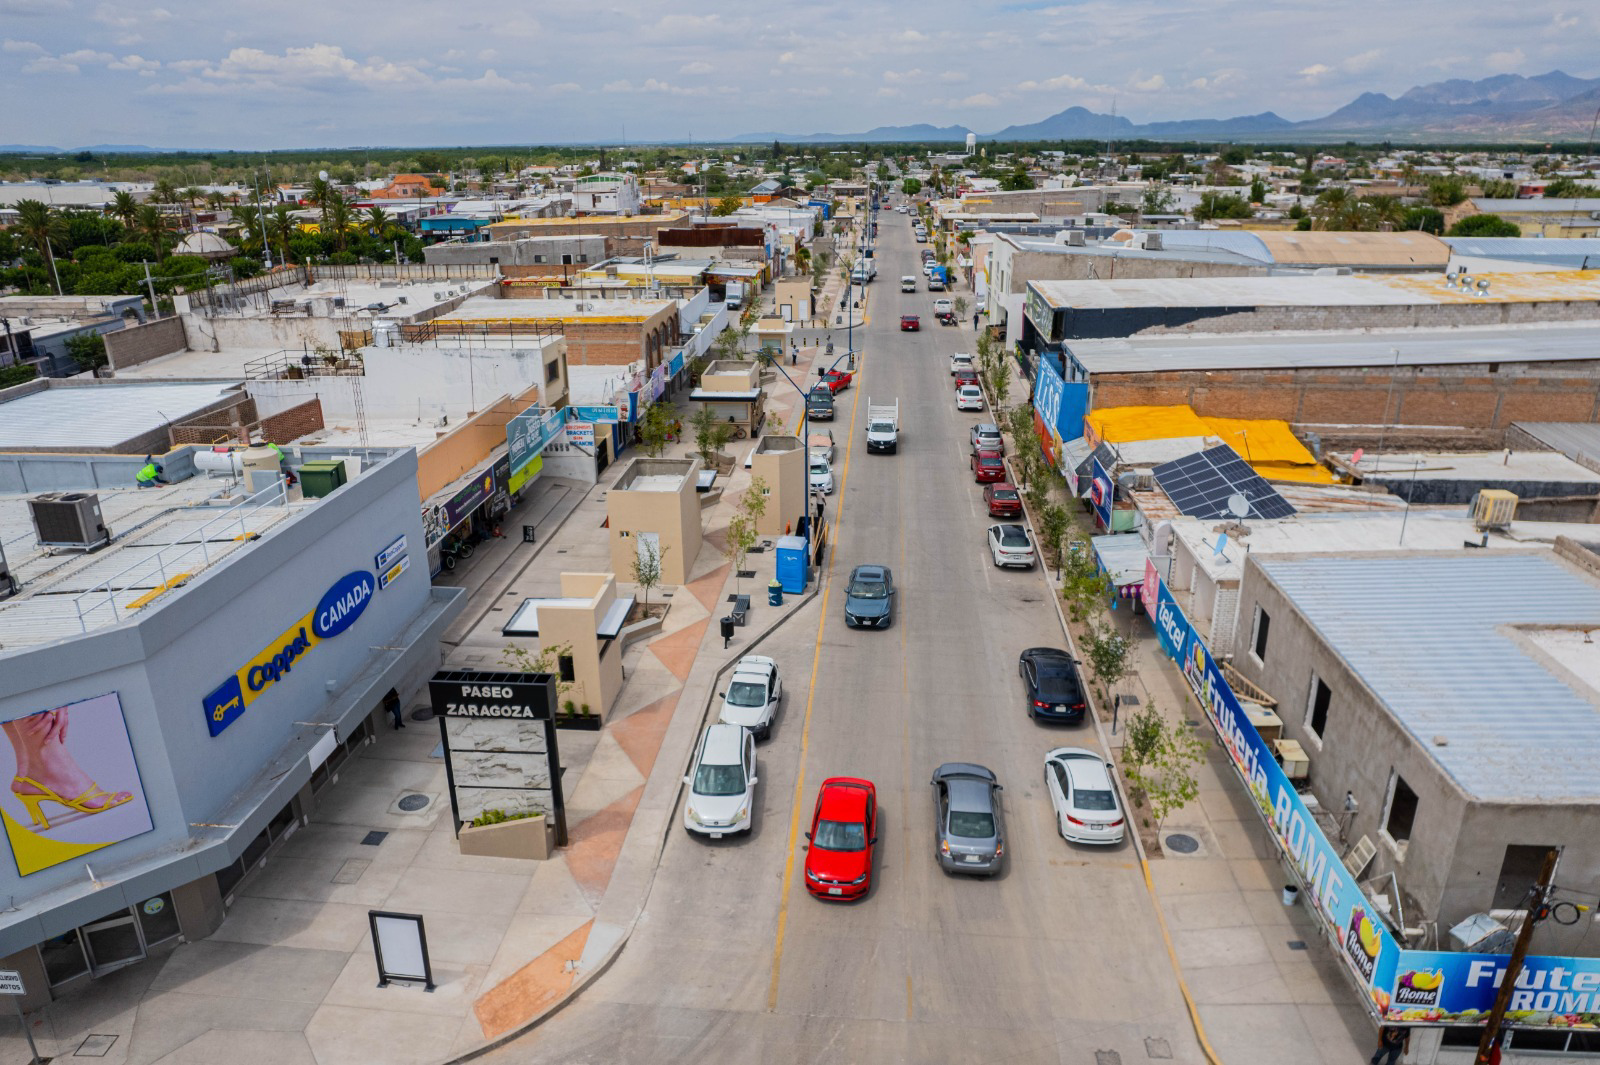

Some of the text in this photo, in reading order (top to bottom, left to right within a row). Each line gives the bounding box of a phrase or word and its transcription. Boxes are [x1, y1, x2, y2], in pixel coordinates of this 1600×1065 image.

[320, 579, 372, 632] CANADA
[1158, 598, 1186, 653] telcel
[247, 627, 311, 691] Coppel
[446, 703, 535, 718] ZARAGOZA
[461, 685, 513, 699] PASEO
[1207, 668, 1343, 922] Fruteria ROME
[1348, 930, 1373, 975] Rome
[1398, 987, 1437, 1000] Rome
